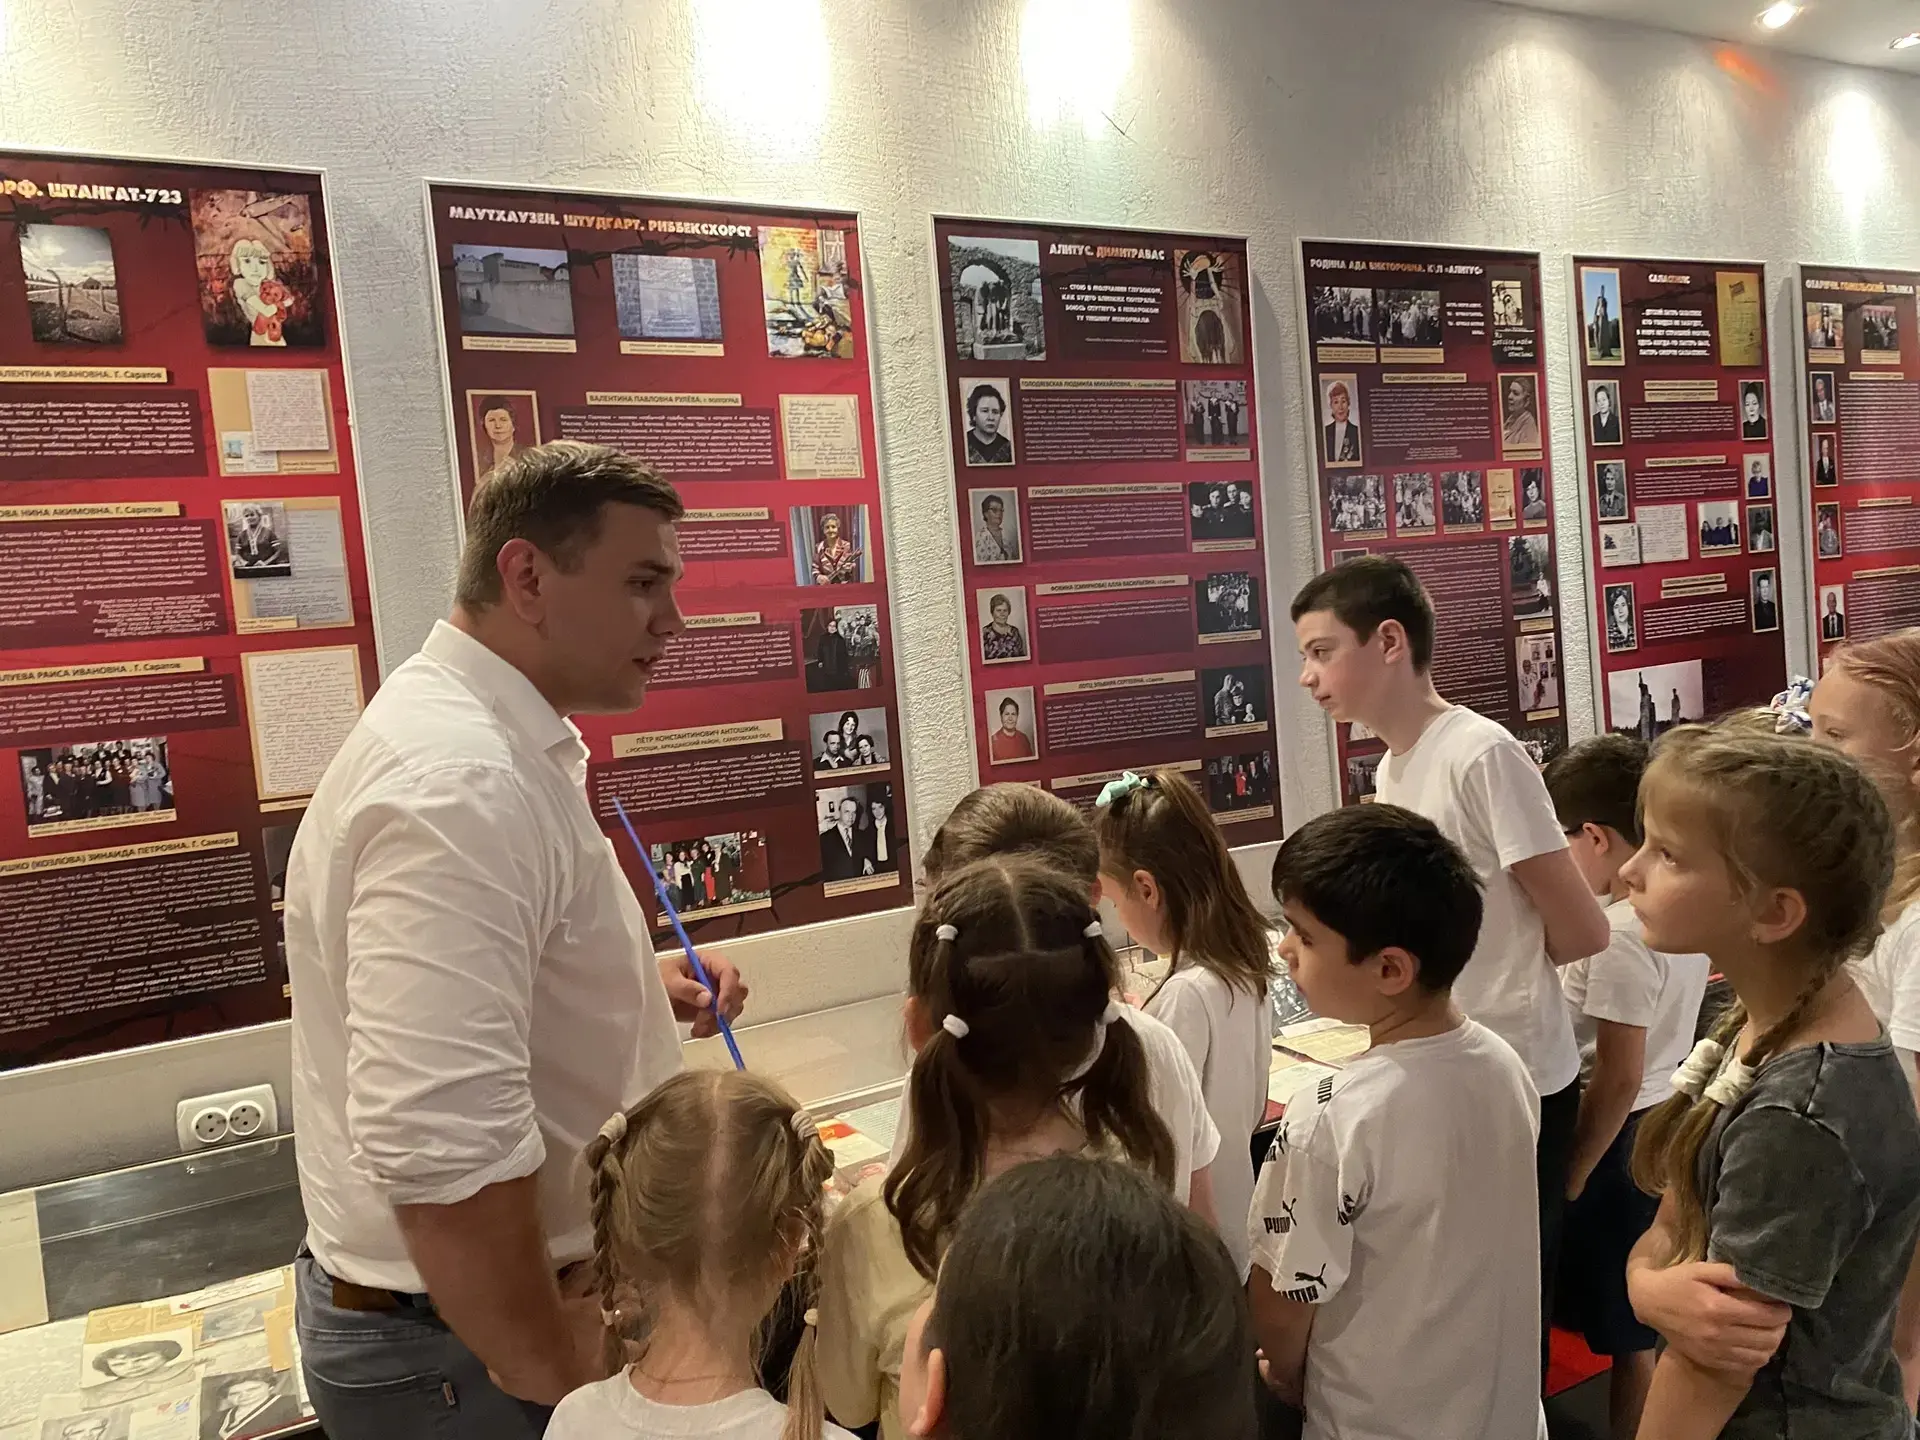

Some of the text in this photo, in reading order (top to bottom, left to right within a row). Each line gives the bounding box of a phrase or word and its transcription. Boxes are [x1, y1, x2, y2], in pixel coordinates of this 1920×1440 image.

[0, 180, 44, 199] РФ.
[449, 205, 561, 226] МАУТХАУЗЕН.
[563, 214, 645, 232] ШТУДГАРТ.
[1095, 245, 1166, 261] ДИМИТРАВАС
[1309, 258, 1347, 271] РОДИНА
[1348, 260, 1368, 271] АДА
[589, 395, 633, 403] ВАЛЕНТИНА
[634, 395, 674, 403] ПАВЛОВНА
[20, 509, 51, 517] НИНА
[0, 672, 36, 682] ЛУЕВА
[37, 670, 71, 679] РАИСА
[636, 735, 654, 745] ПЁТР
[87, 848, 137, 862] ЗИНАИДА
